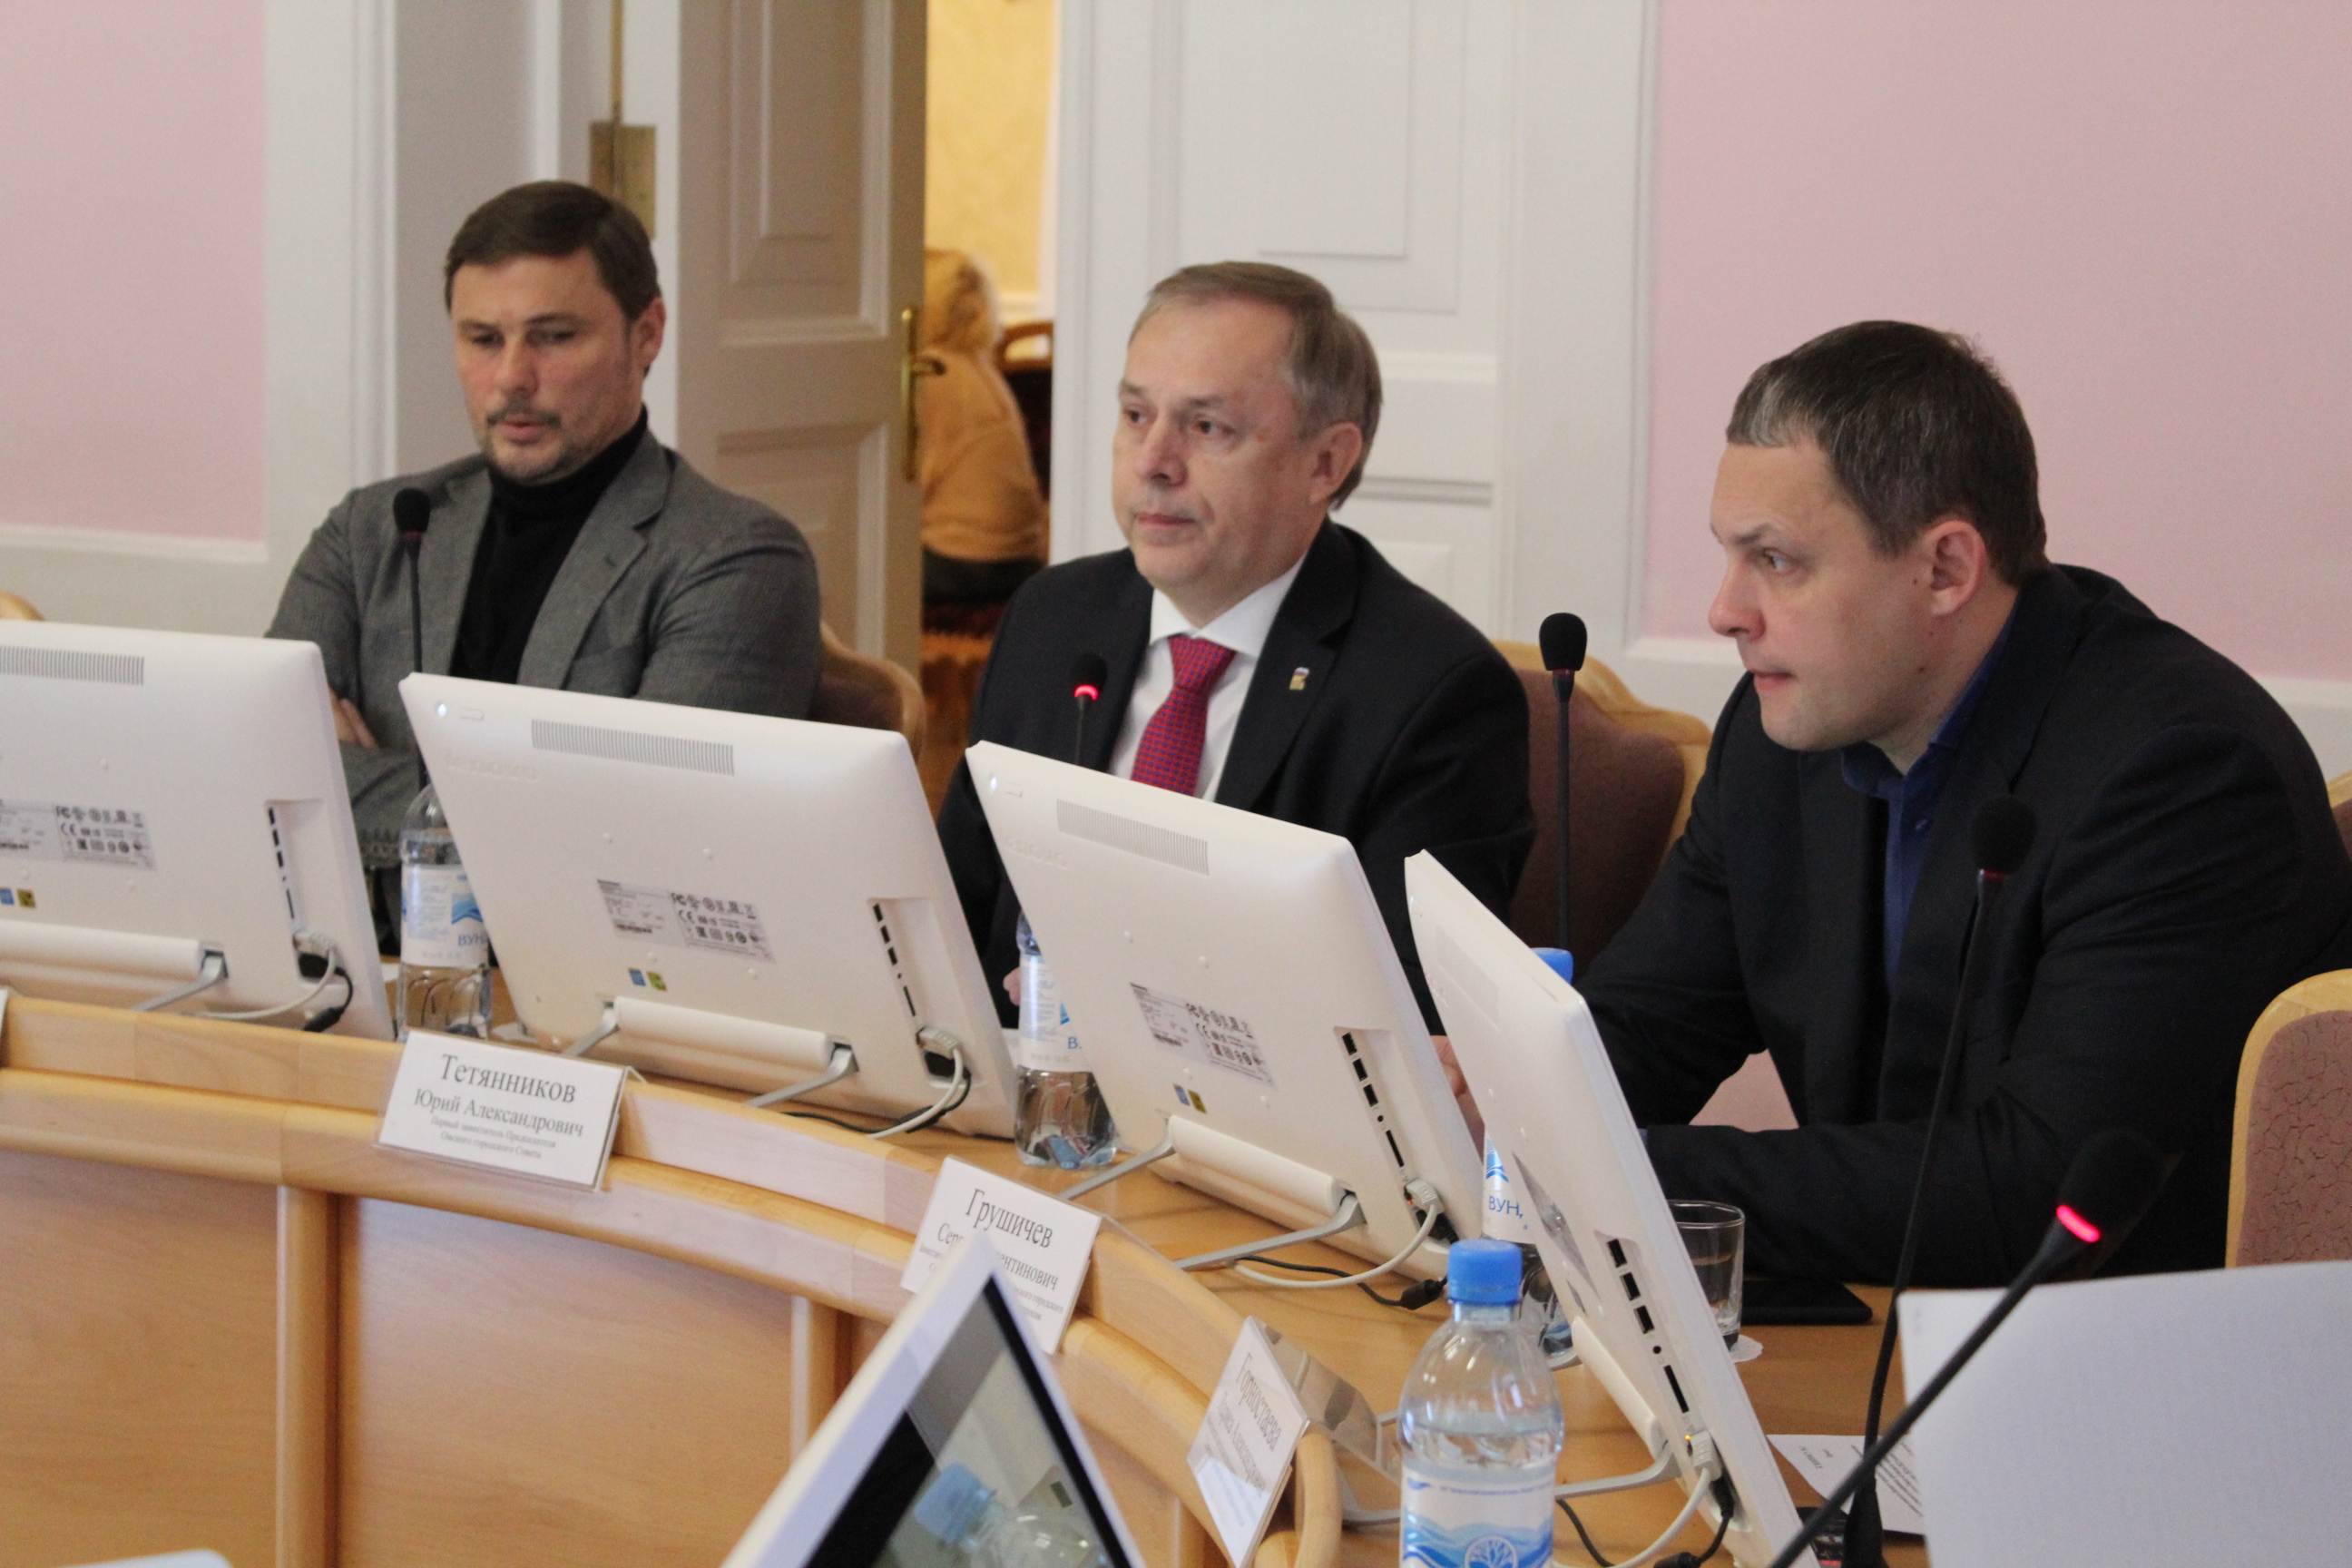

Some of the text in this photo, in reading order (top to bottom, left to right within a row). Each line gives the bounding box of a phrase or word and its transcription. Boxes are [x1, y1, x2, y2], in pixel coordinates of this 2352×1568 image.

[440, 1054, 576, 1103] Тетянников
[414, 1088, 583, 1137] Юрий Александрович
[965, 1189, 1054, 1248] Грушичев
[1489, 1195, 1524, 1219] ВУН
[1235, 1352, 1282, 1452] Горностаева
